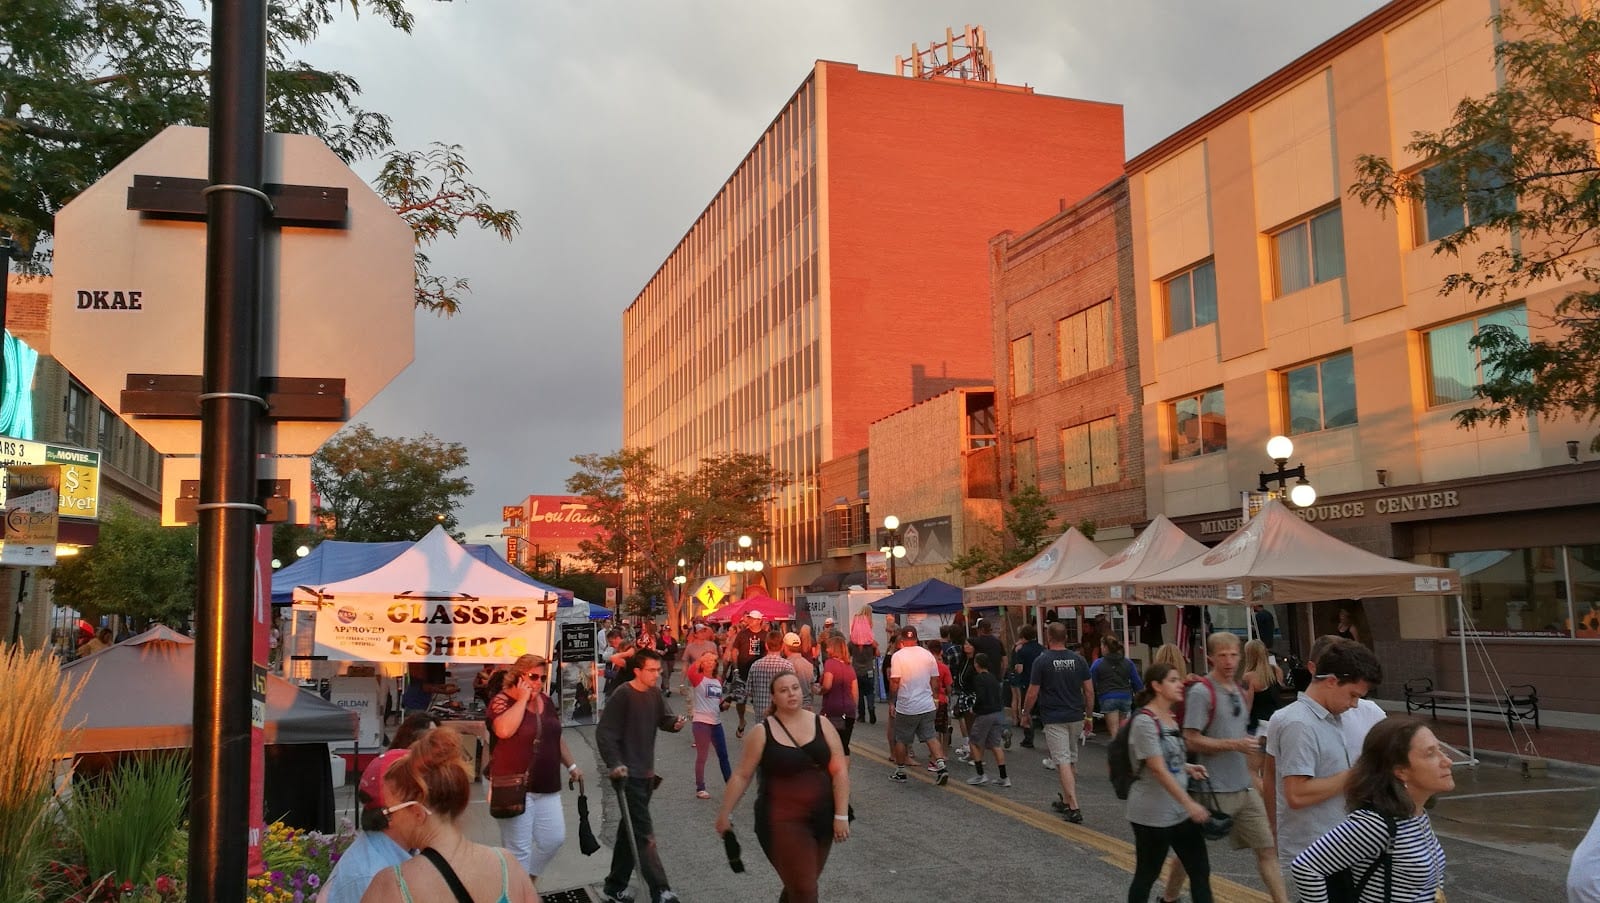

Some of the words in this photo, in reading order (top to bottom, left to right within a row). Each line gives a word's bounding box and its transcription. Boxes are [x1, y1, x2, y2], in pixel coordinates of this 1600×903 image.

[77, 290, 142, 310] DKAE
[18, 444, 25, 457] 3
[58, 494, 96, 510] aver
[531, 500, 565, 523] Lou
[1297, 502, 1365, 523] SOURCE
[1375, 490, 1459, 514] CENTER
[387, 603, 528, 626] GLASSES
[333, 626, 385, 634] APPROVED
[387, 635, 528, 657] T-SHIRTS
